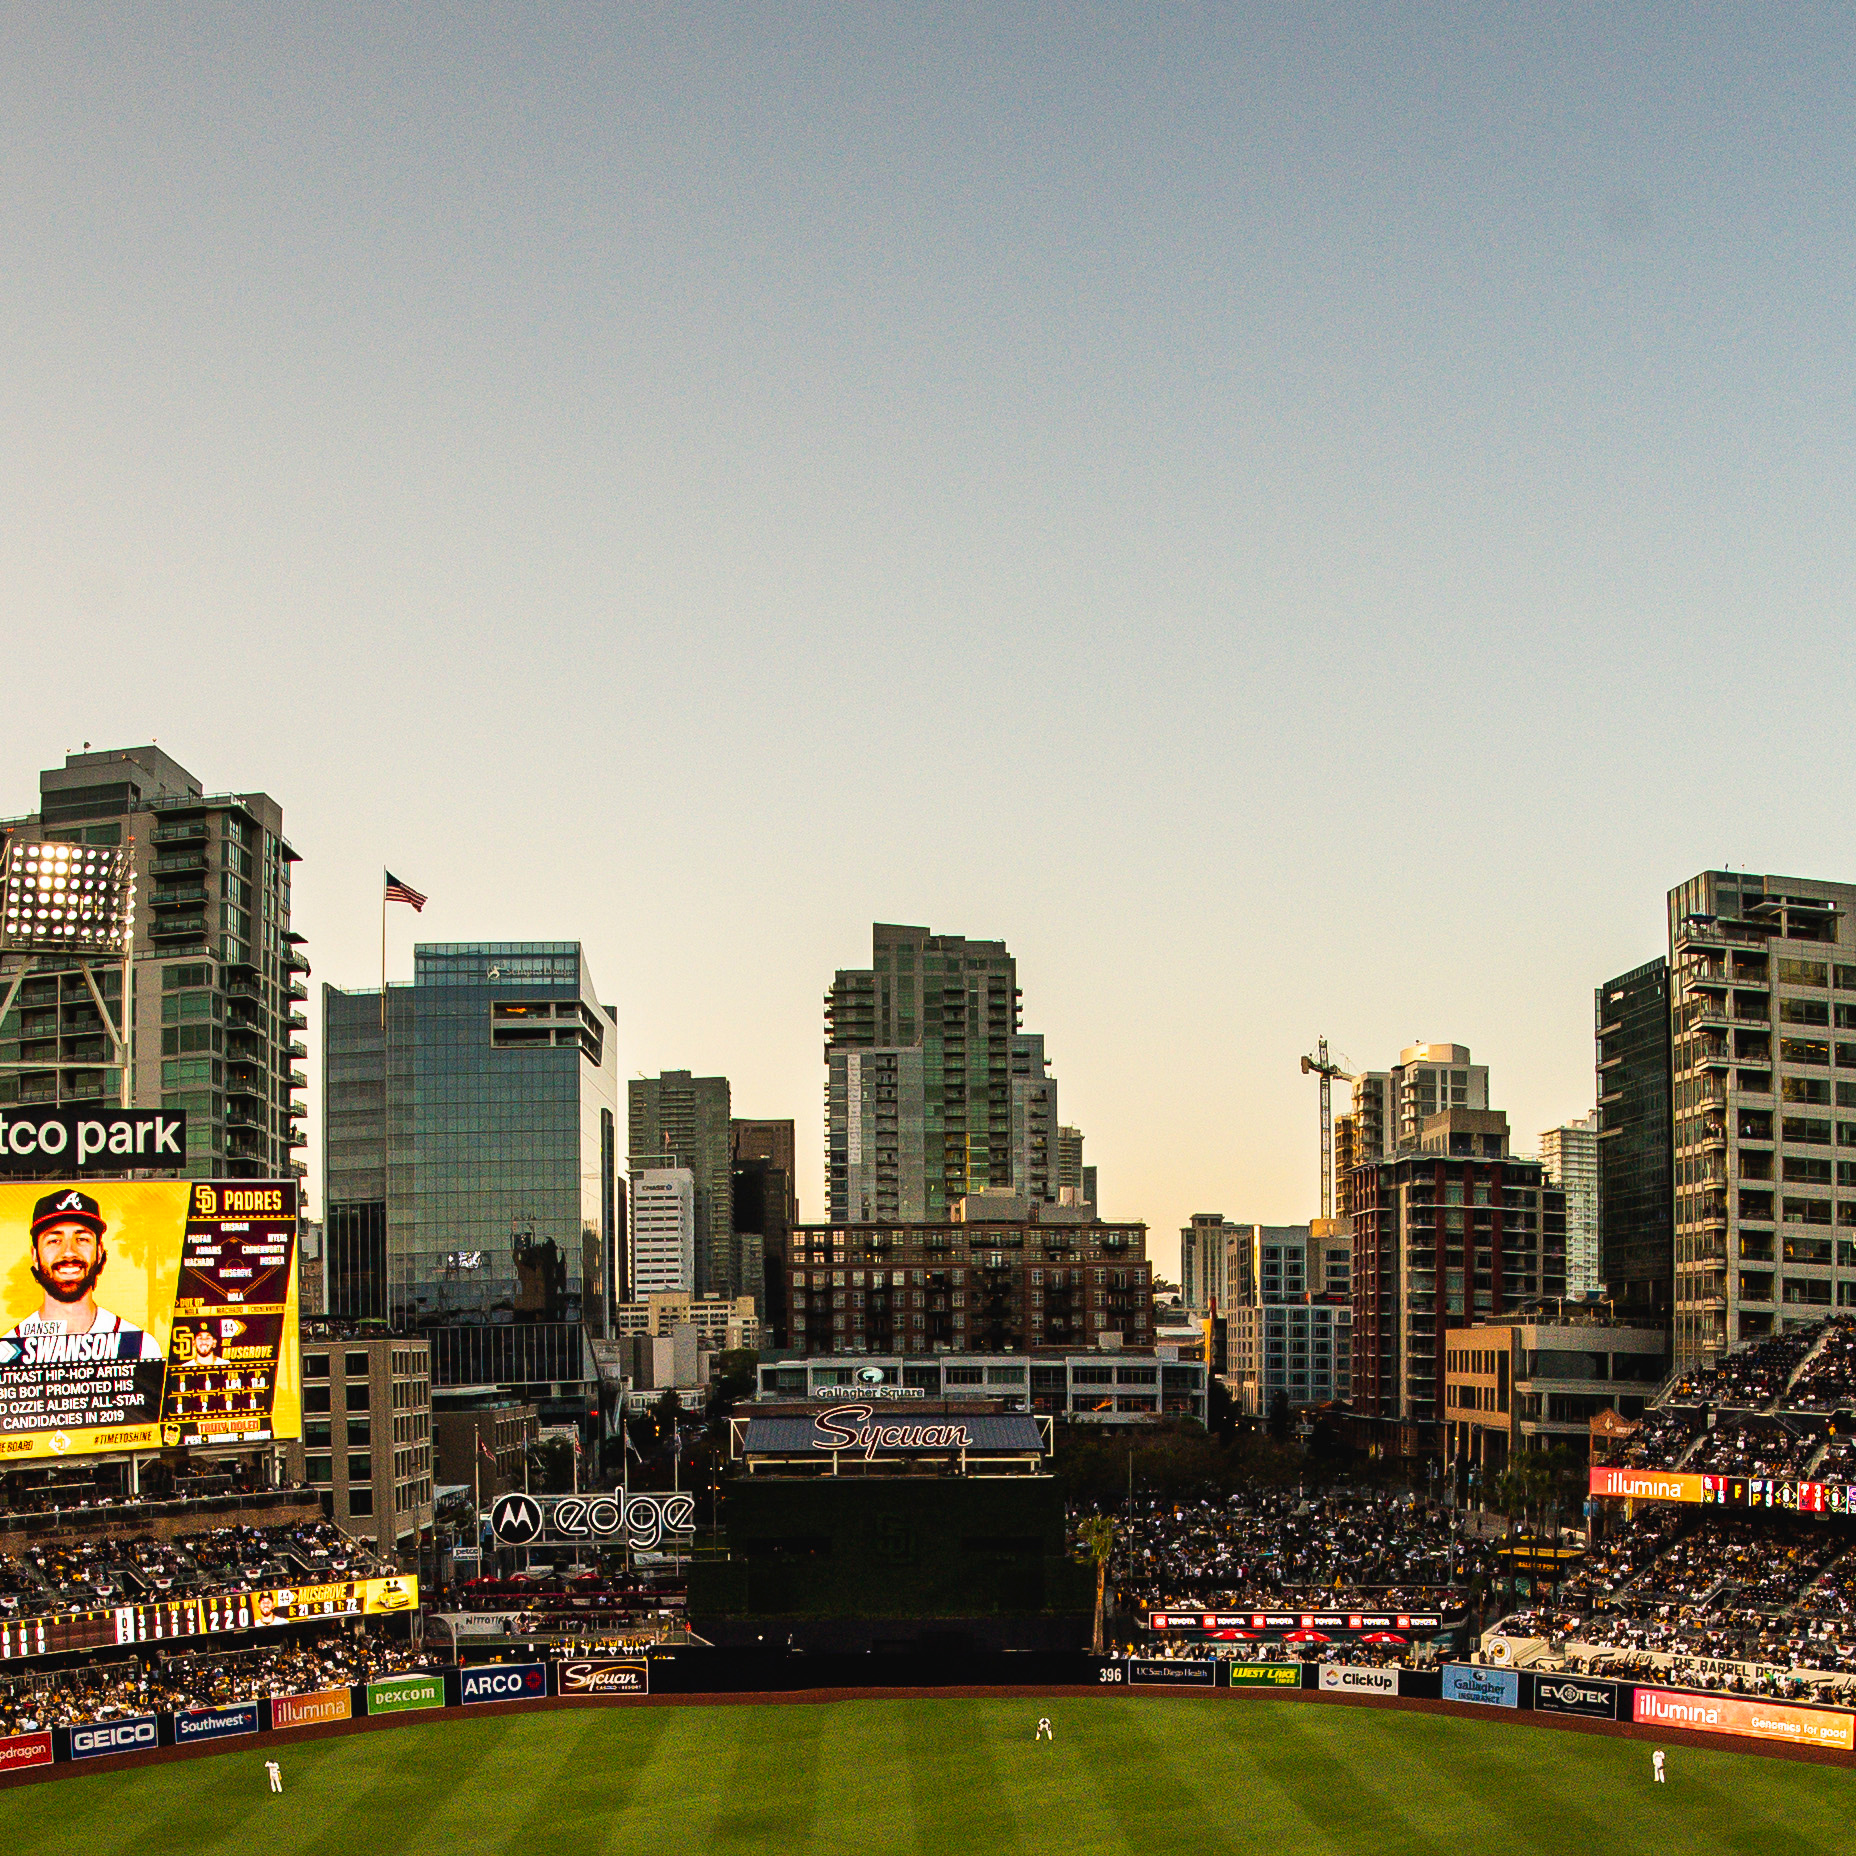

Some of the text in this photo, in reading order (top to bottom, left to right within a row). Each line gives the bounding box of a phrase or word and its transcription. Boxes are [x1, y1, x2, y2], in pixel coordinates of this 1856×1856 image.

[77, 1116, 181, 1164] park
[224, 1190, 281, 1210] PADRES
[24, 1322, 62, 1335] DANSBY
[224, 1324, 233, 1332] 44
[22, 1333, 121, 1364] SWANSON
[222, 1346, 273, 1359] MUSGROVE
[46, 1368, 94, 1382] HIP-HOP
[96, 1365, 136, 1378] ARTIST
[47, 1382, 111, 1396] PROMOTED
[114, 1380, 133, 1393] HIS
[817, 1387, 923, 1400] Gallagher Square
[10, 1401, 44, 1414] OZZIE
[47, 1397, 89, 1412] ALBIES'
[92, 1393, 144, 1408] ALL-STAR
[3, 1410, 124, 1429] CANDIDACIES IN 2019
[95, 1432, 152, 1444] #TIMETOSHINE
[812, 1405, 973, 1460] Sycuan
[1607, 1472, 1682, 1497] illumina
[554, 1486, 696, 1550] edge
[280, 1584, 346, 1603] 44 MUSGROVE
[210, 1608, 249, 1630] 2 2 0
[1168, 1618, 1196, 1626] TOYOTA
[1217, 1618, 1245, 1626] TOYOTA
[1266, 1617, 1293, 1626] TOYOTA
[1314, 1618, 1342, 1626] TOYOTA
[1362, 1618, 1390, 1626] TOYOTA
[1410, 1618, 1437, 1626] TOYOTA
[566, 1664, 637, 1693] Sycuan
[1100, 1668, 1121, 1682] 396
[1232, 1667, 1296, 1680] WEST LAKE
[1343, 1674, 1392, 1688] ClickUp
[465, 1673, 521, 1695] ARCO
[1454, 1679, 1505, 1696] Gallagher
[1541, 1684, 1609, 1704] EVOTEK
[277, 1700, 345, 1722] illumina
[1640, 1695, 1718, 1724] illumina
[181, 1714, 243, 1734] Southwest
[1752, 1717, 1846, 1739] Genomics for good
[75, 1723, 154, 1750] GEICO
